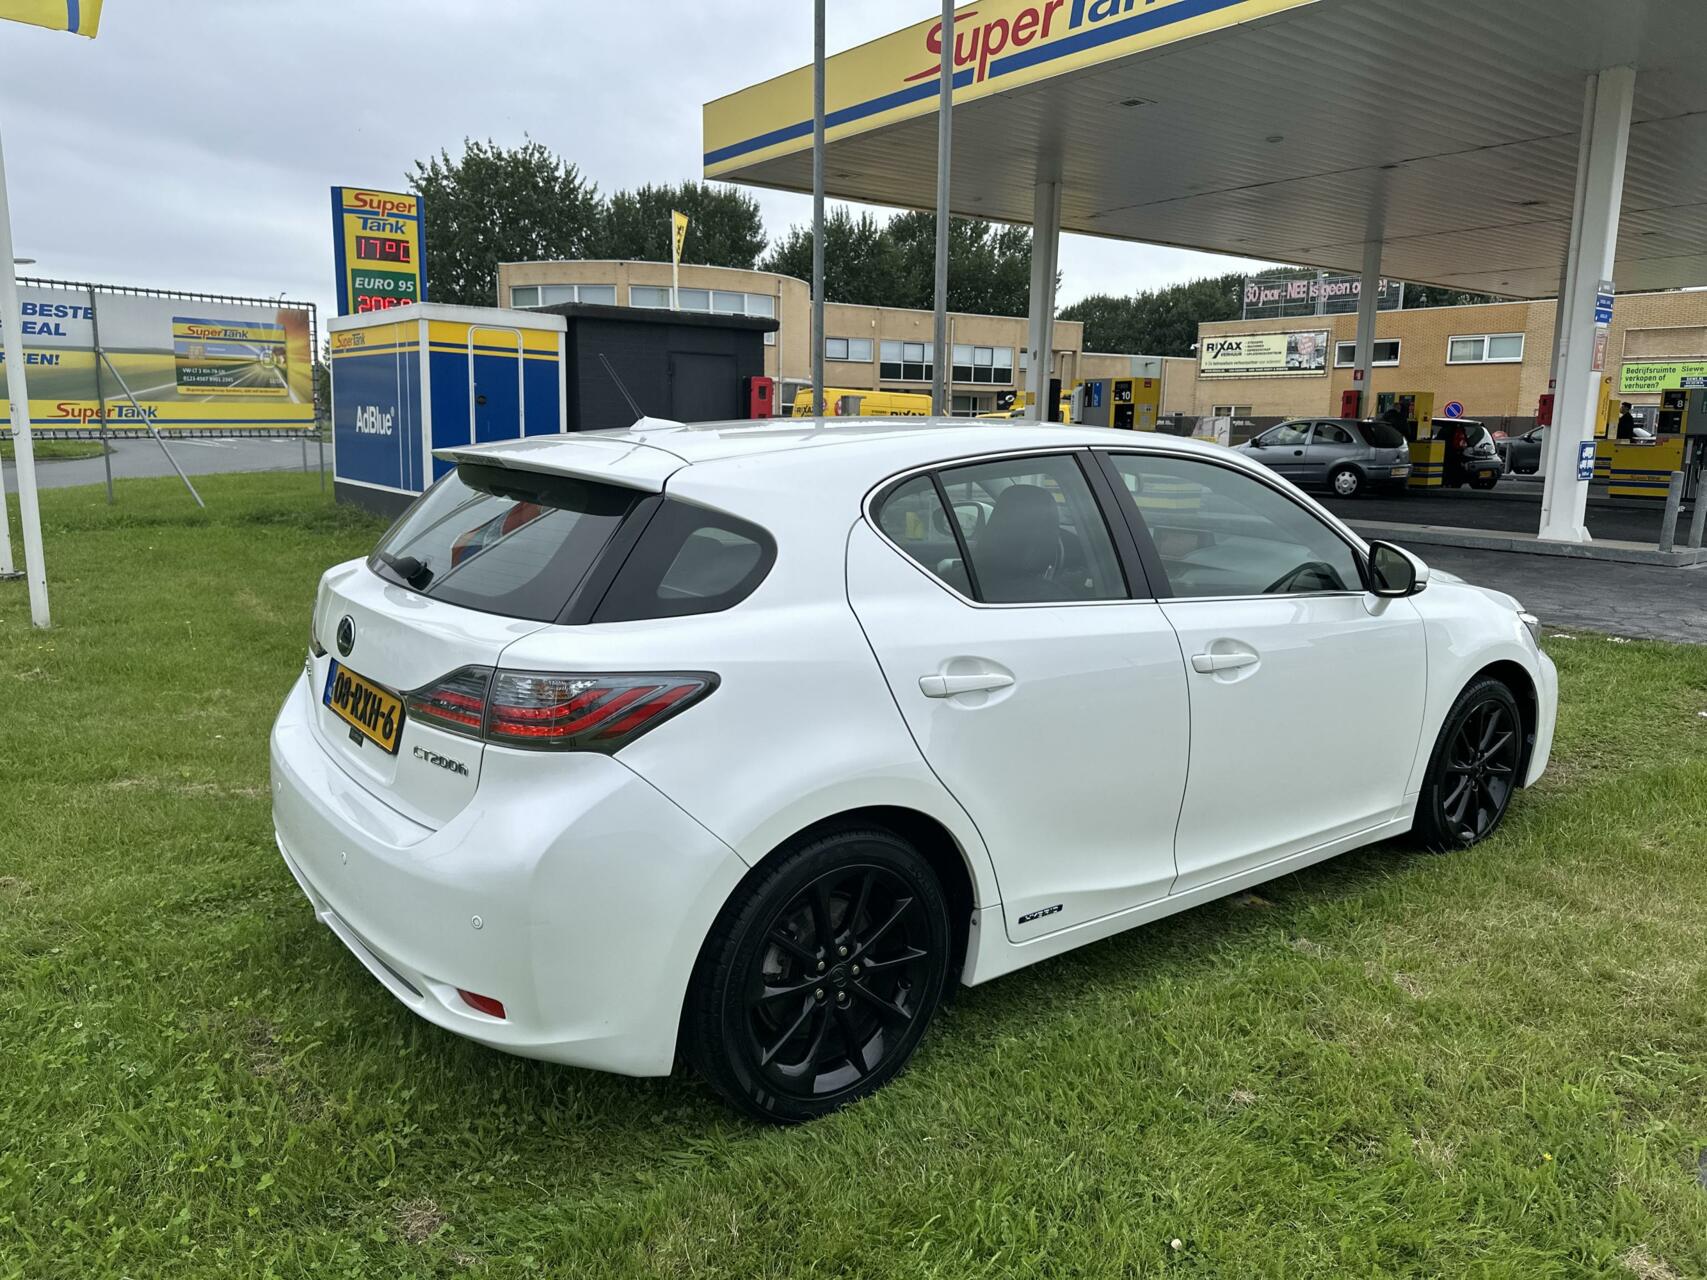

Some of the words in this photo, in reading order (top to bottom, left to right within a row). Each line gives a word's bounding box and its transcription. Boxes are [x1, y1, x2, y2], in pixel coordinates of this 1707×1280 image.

[343, 192, 415, 217] Super
[355, 216, 406, 234] Tank
[355, 277, 394, 290] EURO
[398, 281, 414, 292] 95
[1259, 286, 1280, 307] jaar
[1287, 281, 1307, 299] NEE
[1321, 282, 1350, 300] geen
[21, 302, 94, 320] BESTE
[20, 321, 67, 336] EAL
[184, 325, 249, 340] SuperTank
[1206, 340, 1243, 359] RIXAX
[1625, 375, 1657, 383] verkopen
[1626, 367, 1677, 375] Bedrijfsruimte
[1121, 391, 1131, 400] 10
[1677, 400, 1684, 408] 8
[333, 671, 396, 741] 08-RXH-6
[413, 745, 470, 777] CT200h
